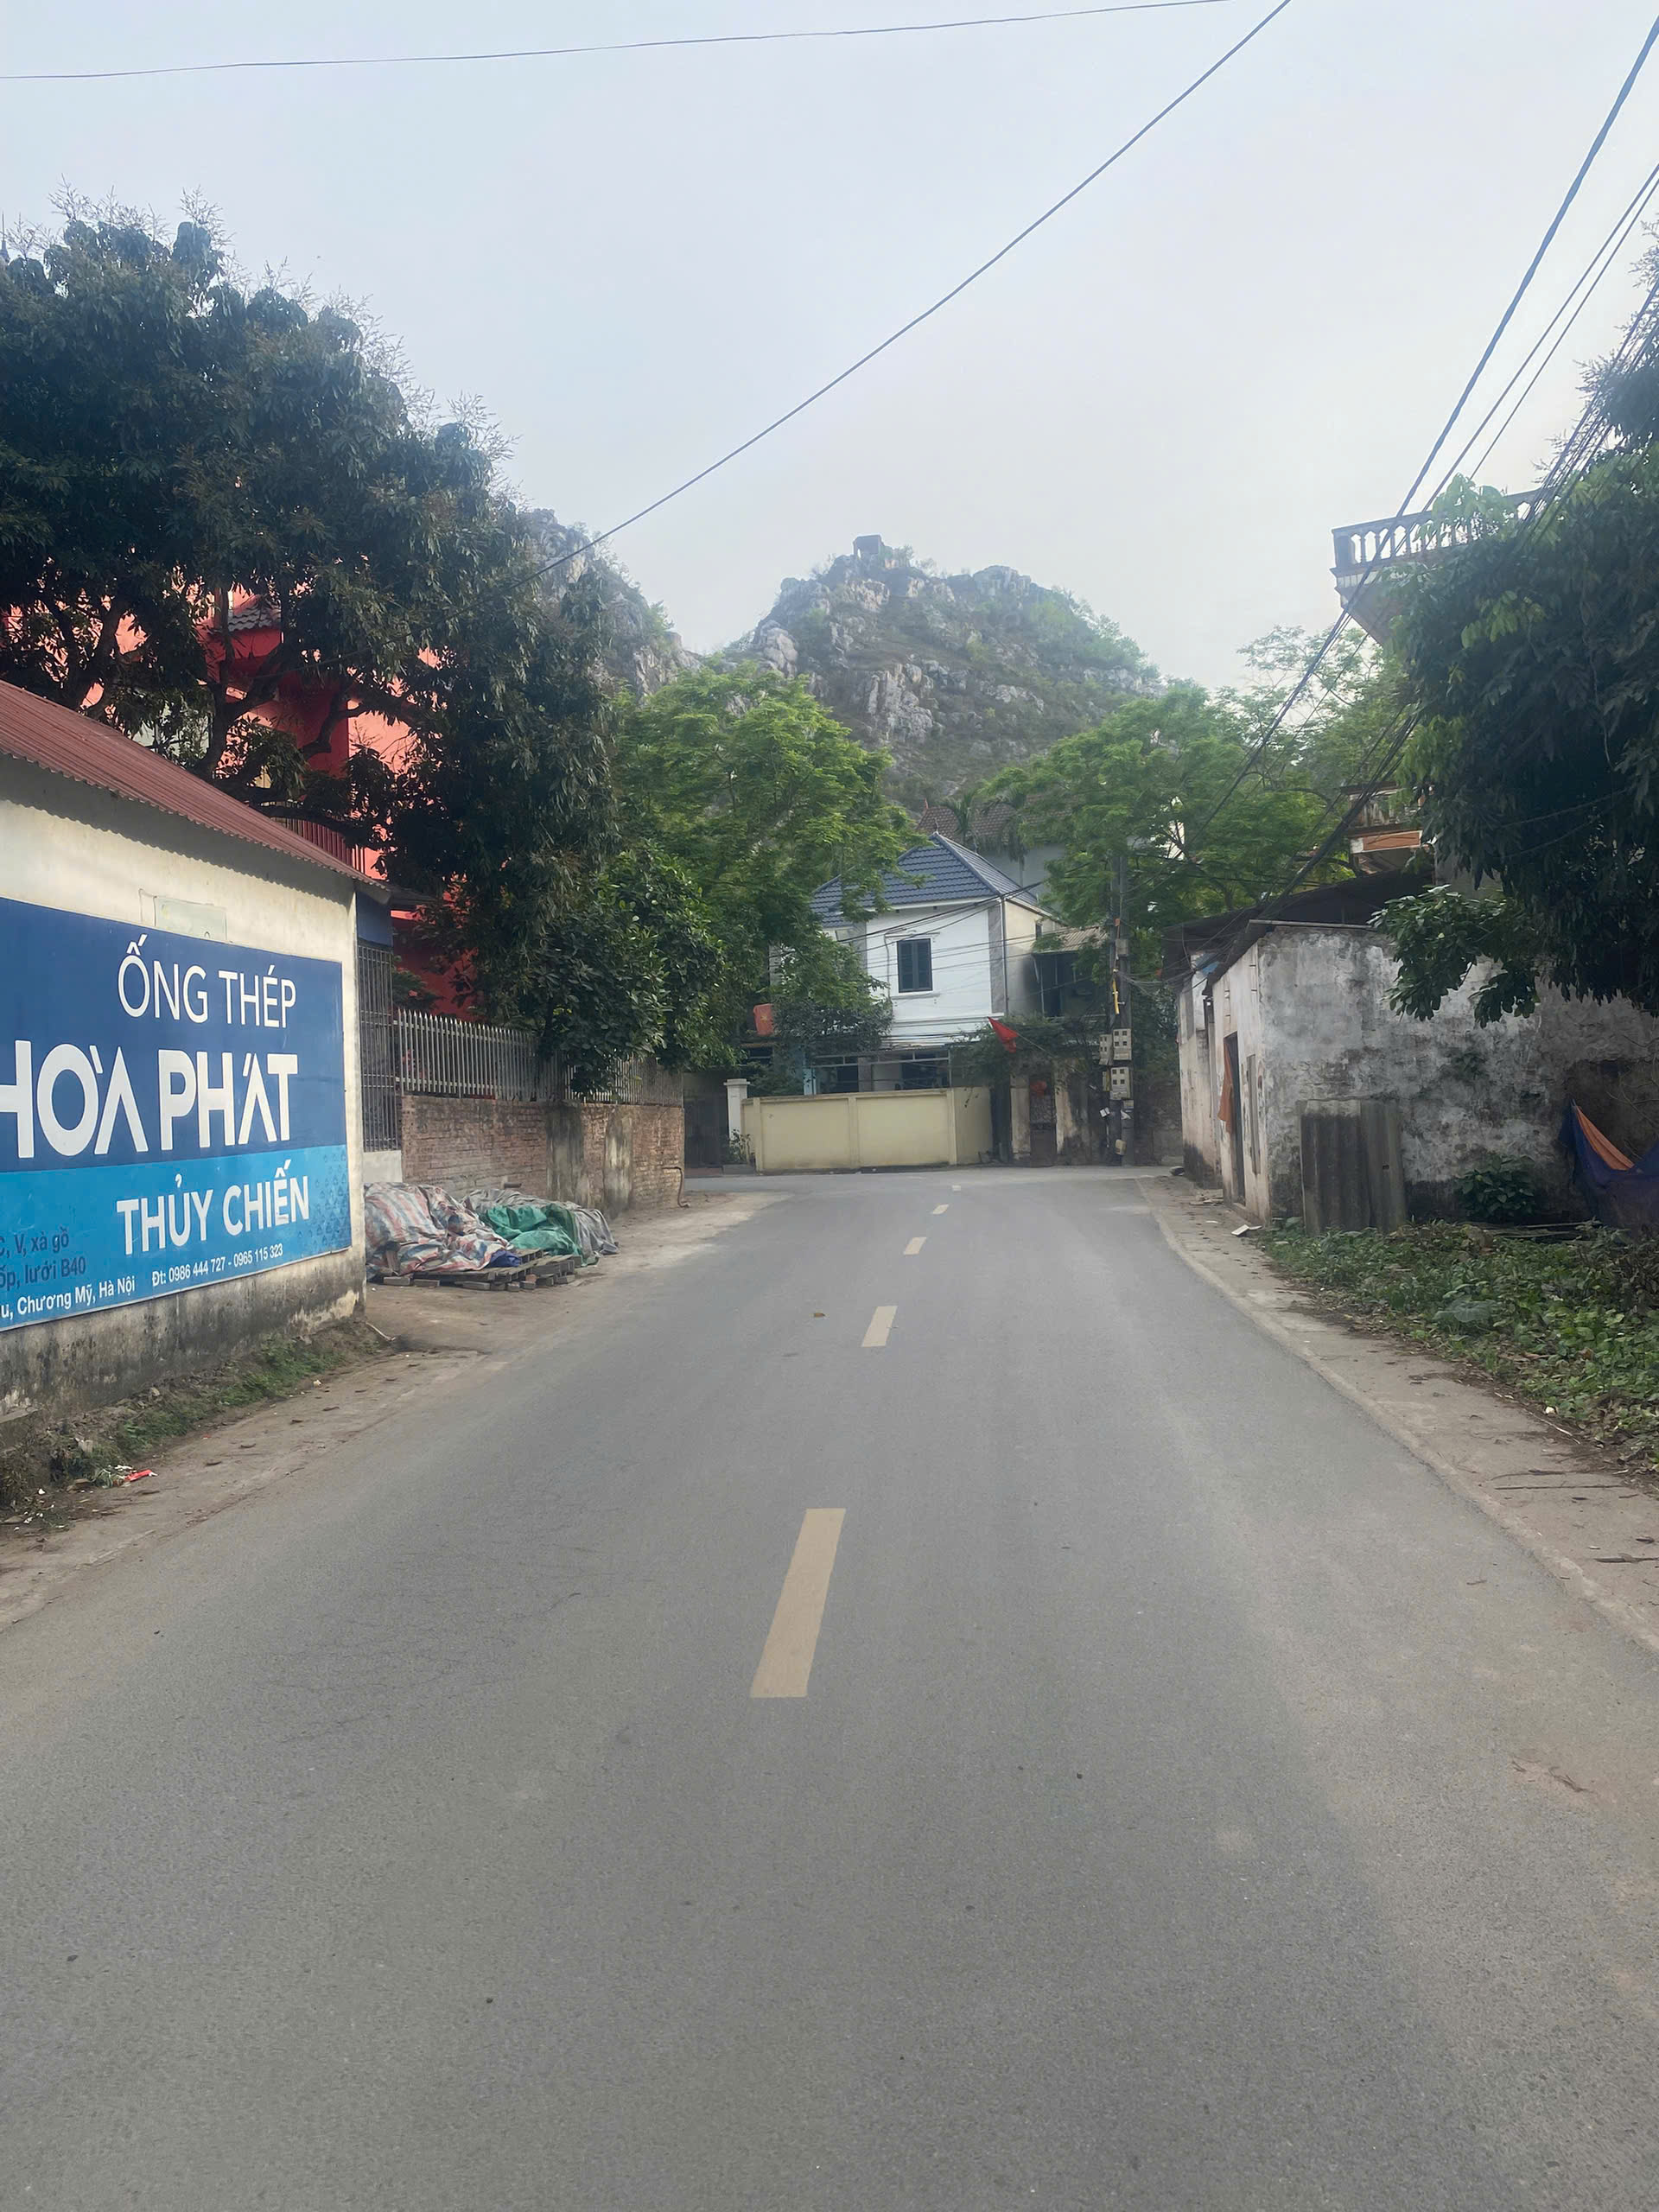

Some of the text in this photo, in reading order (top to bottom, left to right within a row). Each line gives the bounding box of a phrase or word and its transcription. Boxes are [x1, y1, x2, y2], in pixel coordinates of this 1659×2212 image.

[118, 933, 296, 1028] ỐNG THÉP
[158, 1049, 298, 1151] PHÁT
[31, 1230, 48, 1252] xà
[52, 1227, 69, 1253] gồ
[117, 1159, 309, 1255] THỦY CHIẾN
[17, 1292, 72, 1315] Chương
[75, 1284, 96, 1306] Mỹ,
[99, 1280, 114, 1298] Hà
[117, 1275, 136, 1296] Nội
[152, 1270, 167, 1287] Đt:
[168, 1264, 191, 1282] 0986
[193, 1261, 209, 1277] 444
[211, 1257, 226, 1273] 727
[233, 1250, 253, 1268] 0965
[254, 1246, 268, 1262] 115
[269, 1243, 283, 1258] 323
[25, 1261, 57, 1284] lưới
[61, 1256, 86, 1278] B40
